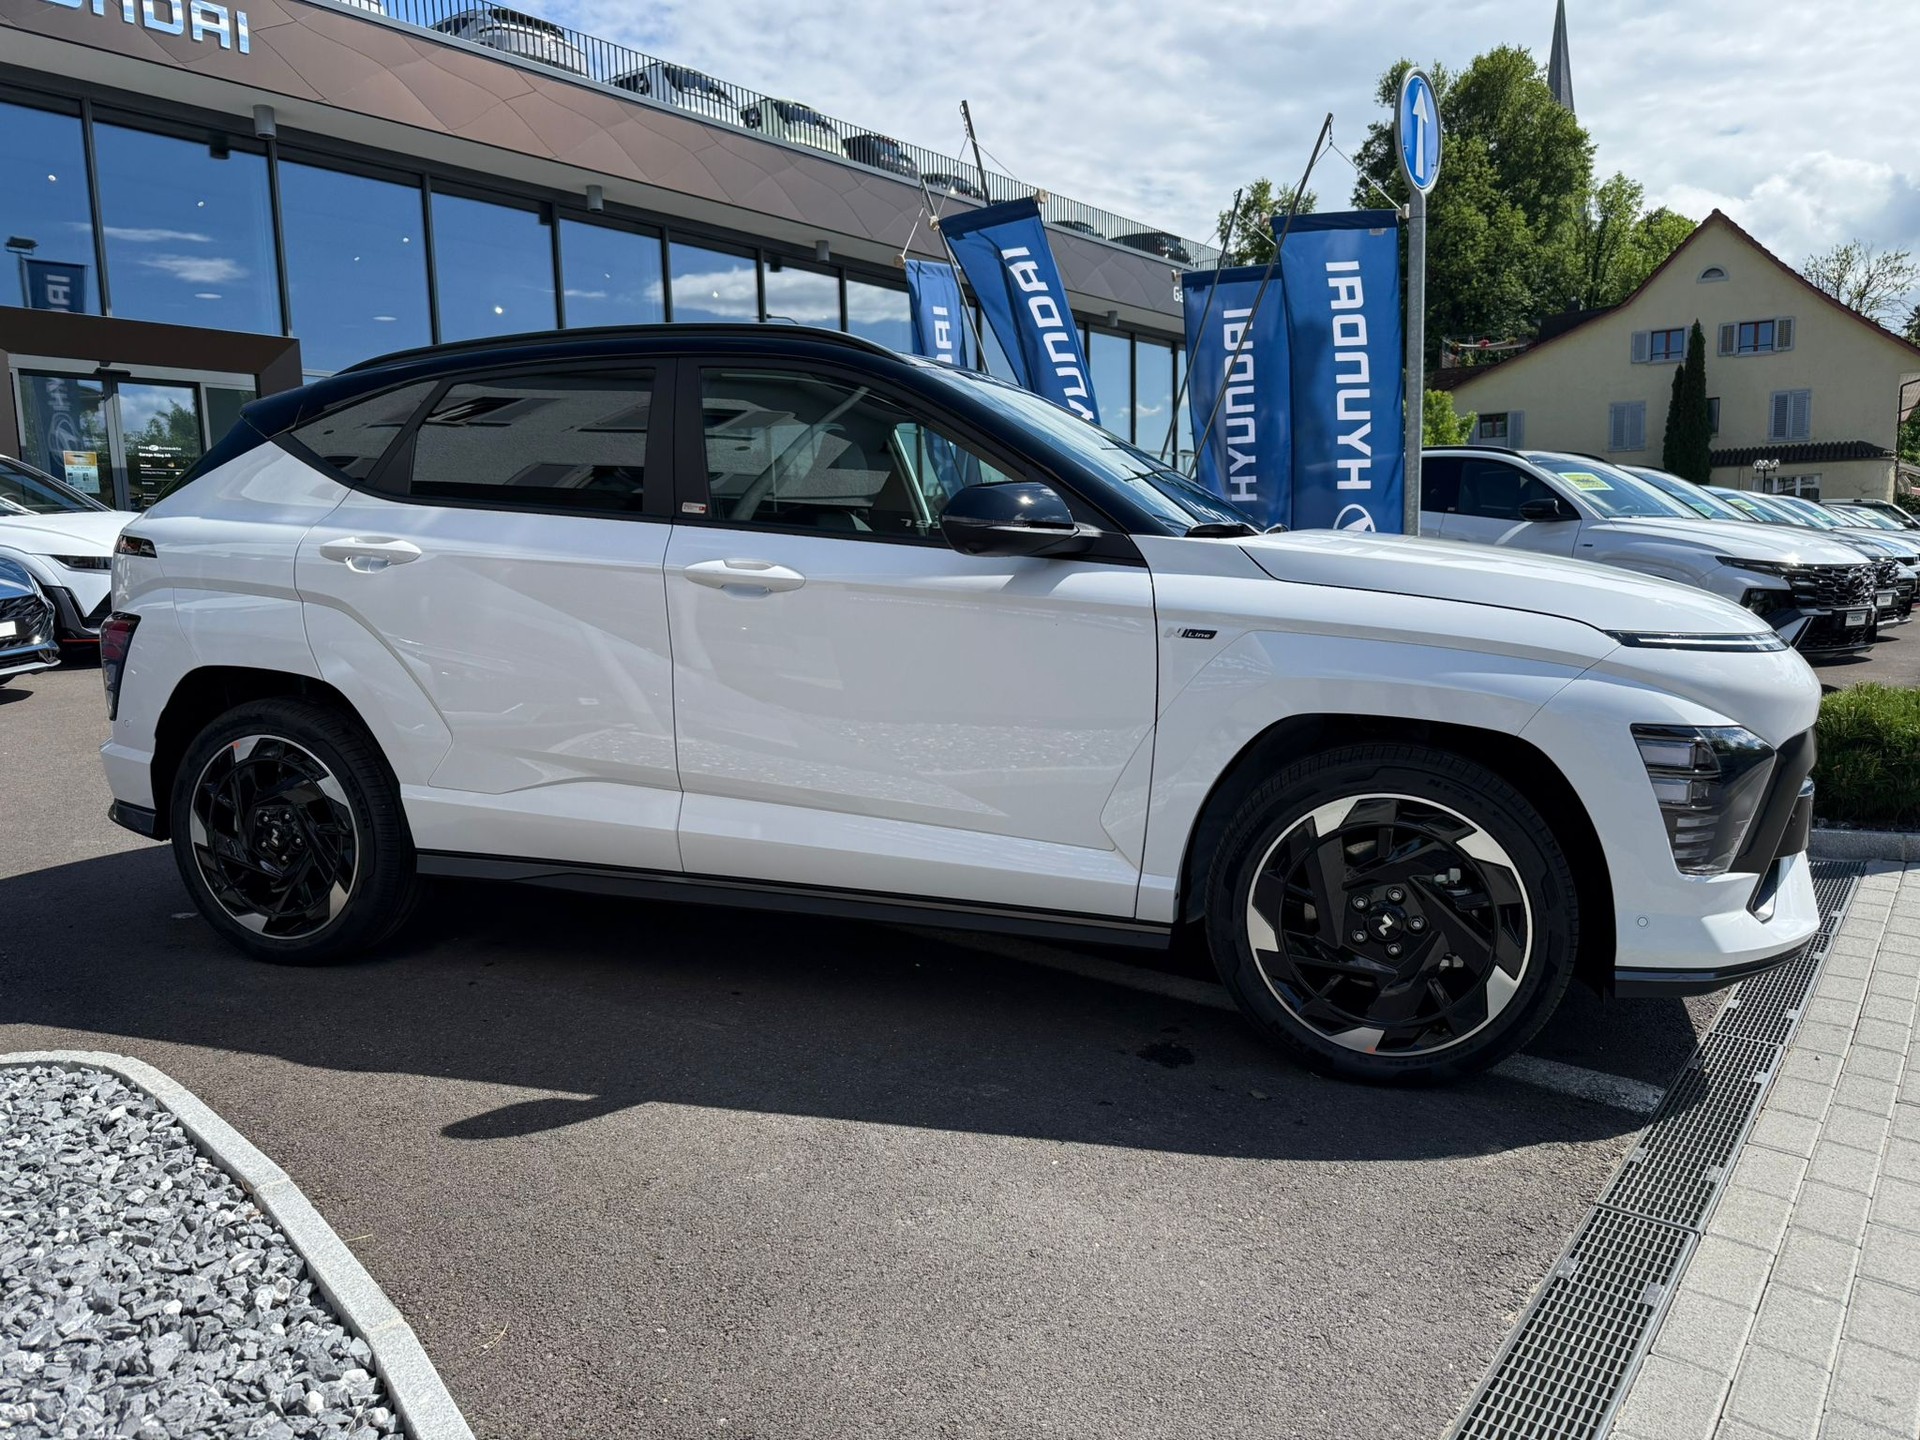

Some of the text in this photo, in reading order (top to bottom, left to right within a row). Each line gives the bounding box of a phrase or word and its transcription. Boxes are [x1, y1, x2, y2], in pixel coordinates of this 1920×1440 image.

[40, 0, 250, 54] DAI
[1001, 246, 1095, 421] YUNDAI
[1222, 308, 1258, 502] HYUNDAI
